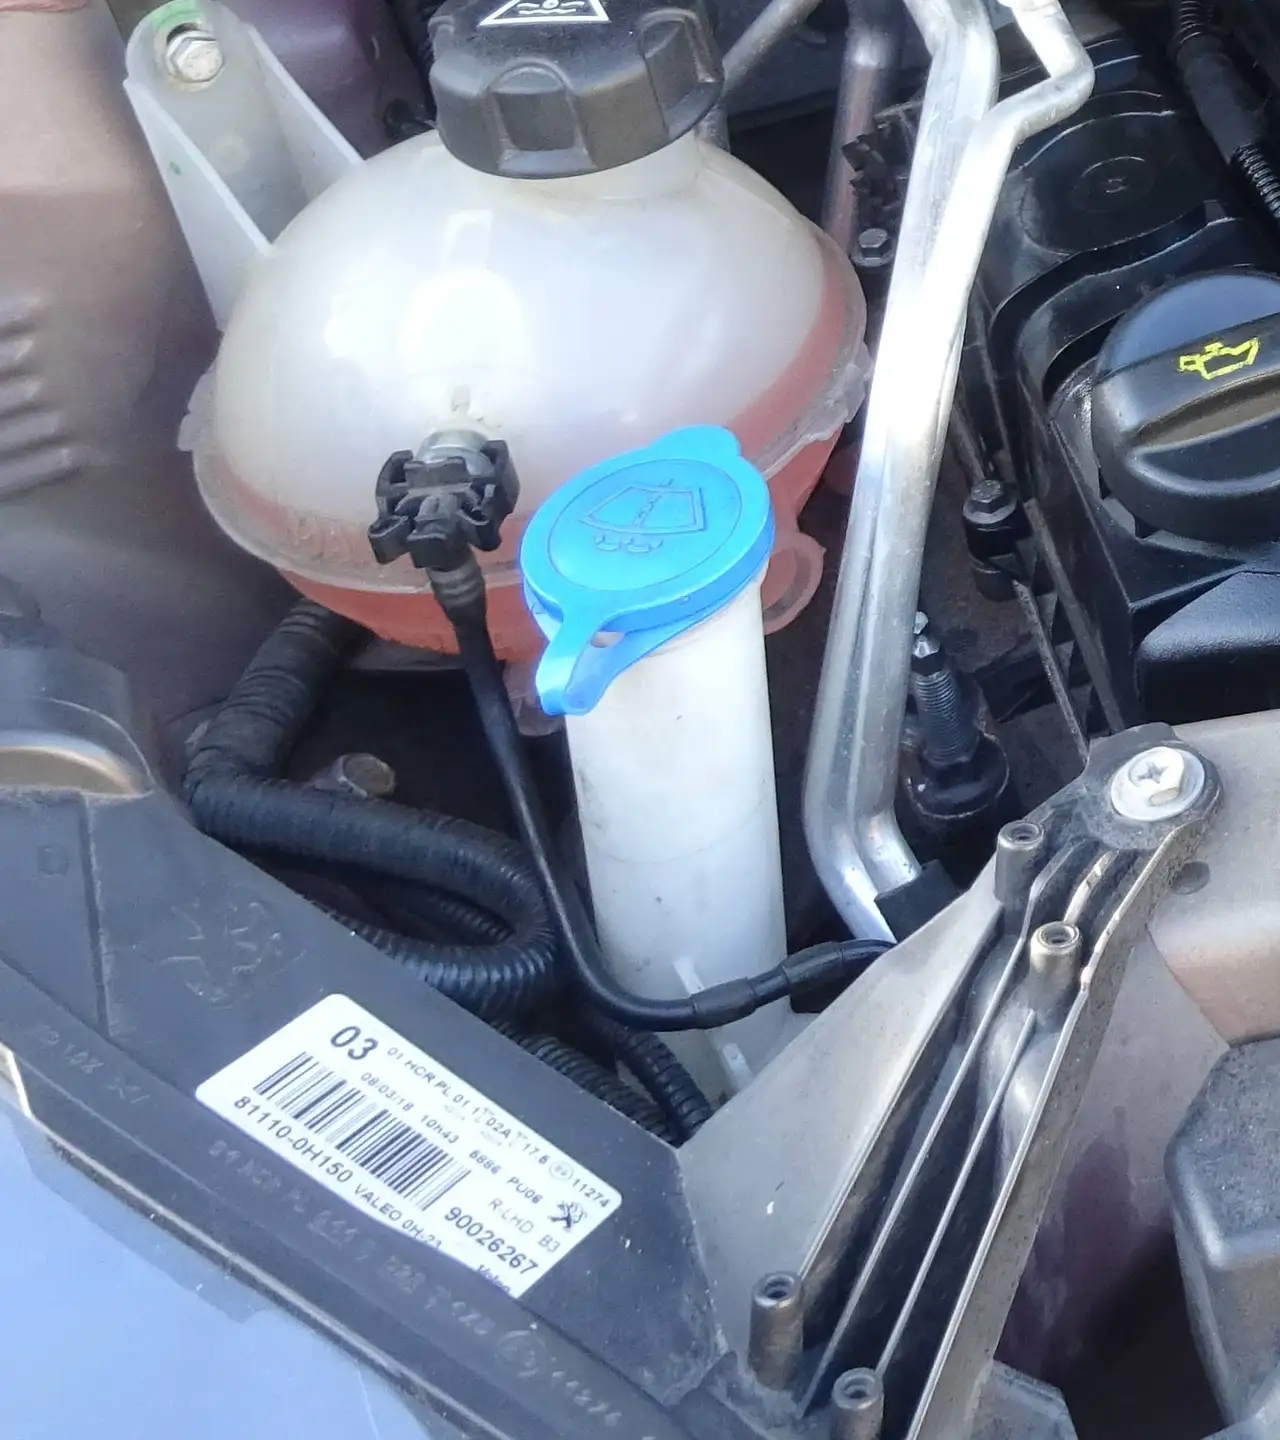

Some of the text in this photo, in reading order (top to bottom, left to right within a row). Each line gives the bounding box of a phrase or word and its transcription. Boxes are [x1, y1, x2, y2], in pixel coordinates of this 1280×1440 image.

[330, 1025, 378, 1061] 03
[361, 1071, 415, 1112] 08/03/18
[421, 1114, 459, 1144] 10h43
[386, 1046, 405, 1061] 01
[404, 1059, 436, 1083] HCR
[433, 1080, 452, 1097] PL
[485, 1116, 512, 1139] 02A
[571, 1177, 611, 1209] 11274
[233, 1095, 354, 1183] 81110-0H150
[354, 1183, 403, 1222] VALEO
[444, 1206, 539, 1275] 90026267
